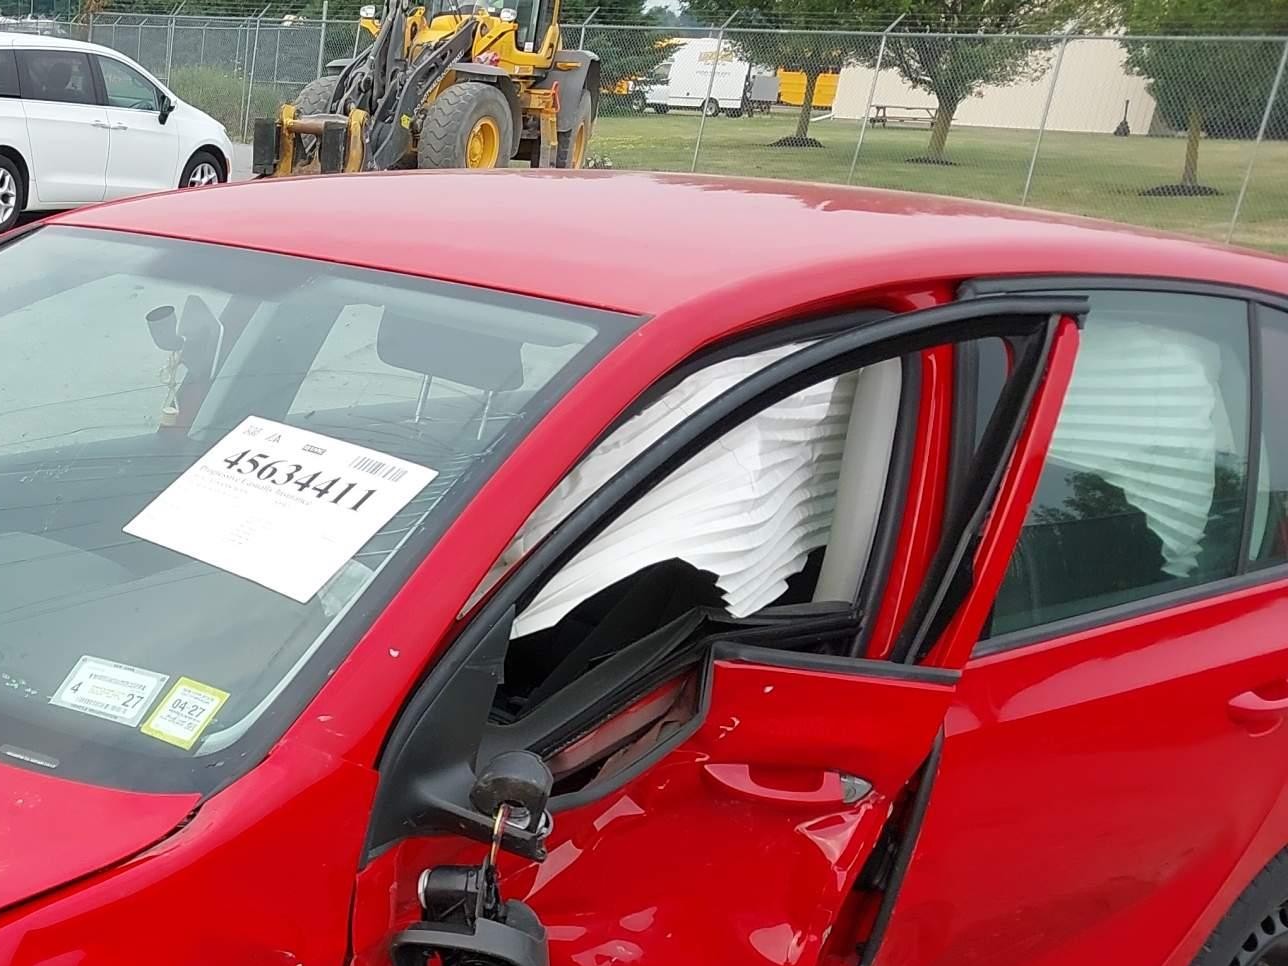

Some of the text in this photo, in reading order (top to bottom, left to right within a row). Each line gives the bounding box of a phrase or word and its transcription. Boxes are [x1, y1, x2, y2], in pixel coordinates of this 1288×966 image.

[223, 449, 378, 512] 45634411
[70, 681, 83, 694] 4
[121, 693, 145, 709] 27
